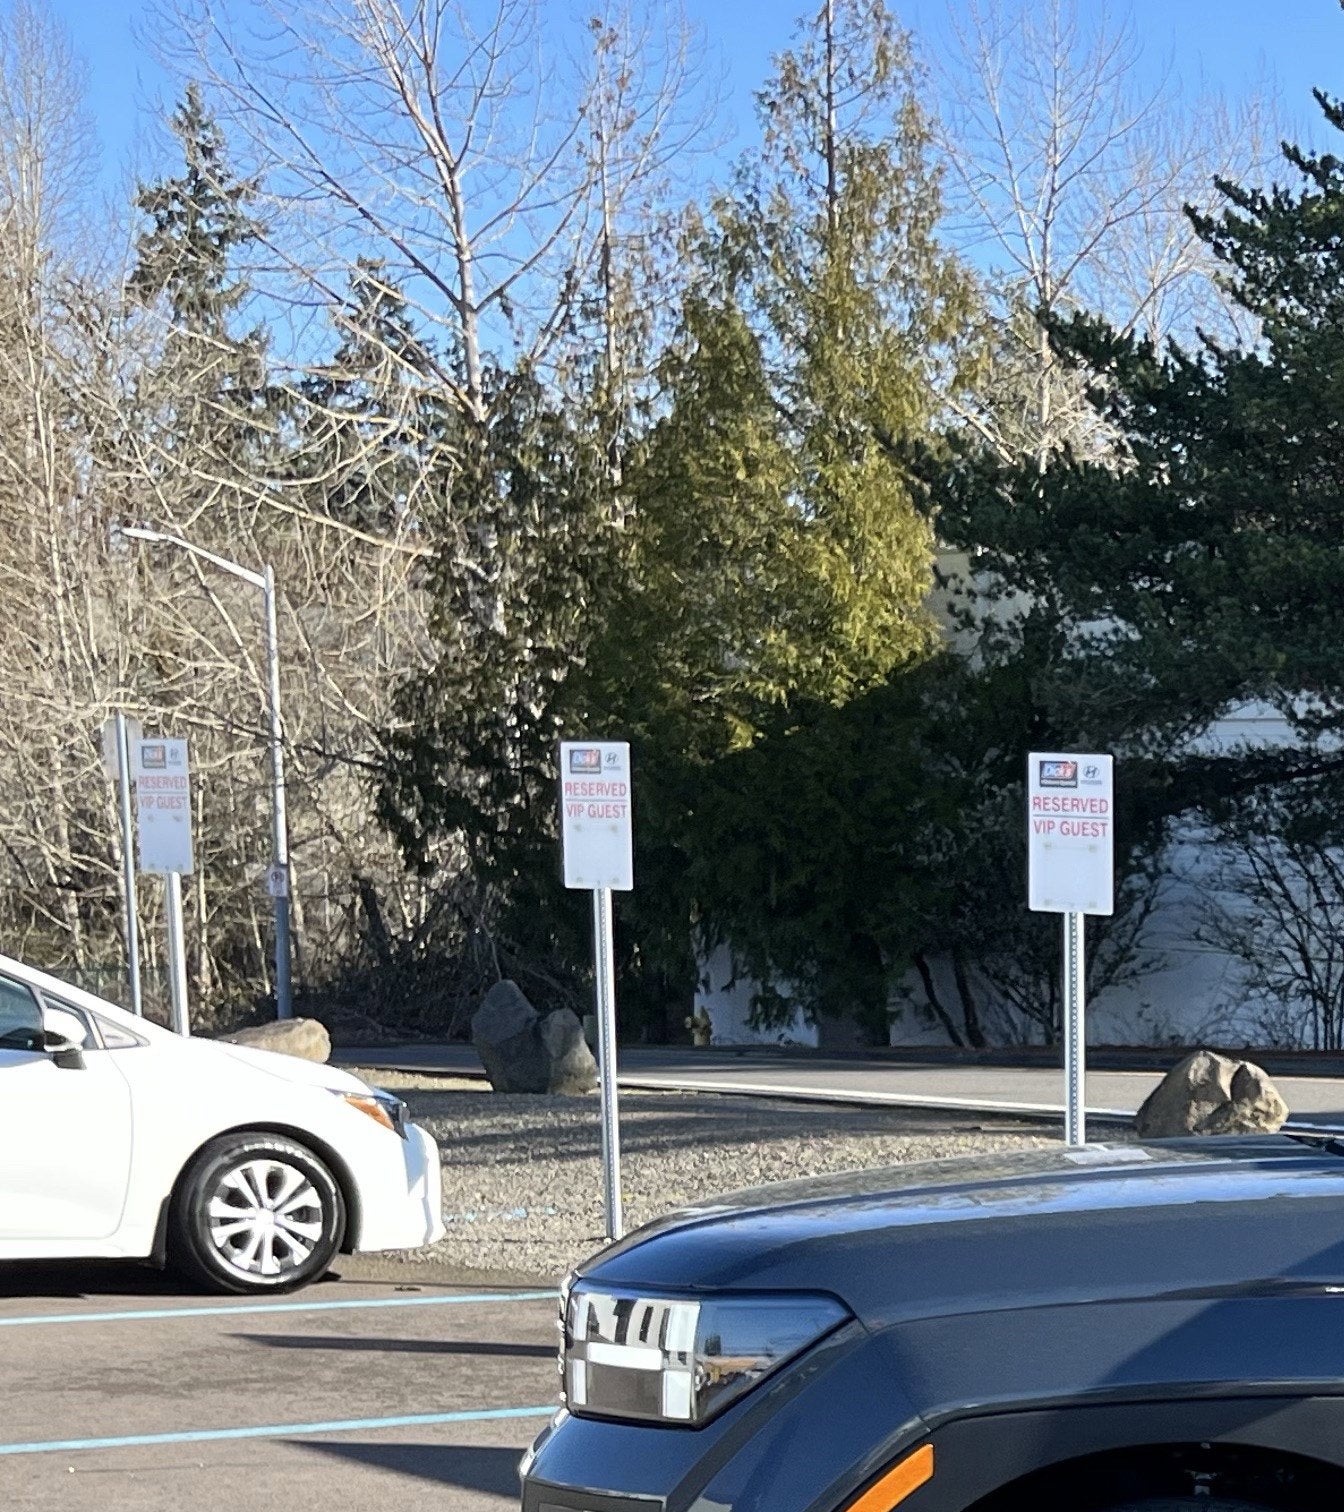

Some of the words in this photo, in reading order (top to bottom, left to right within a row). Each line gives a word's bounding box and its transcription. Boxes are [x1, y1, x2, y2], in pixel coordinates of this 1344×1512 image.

[138, 775, 187, 789] RESERVED
[564, 782, 627, 797] RESERVED
[140, 795, 154, 809] VIP
[157, 796, 187, 810] GUEST
[1032, 796, 1108, 813] RESERVED
[566, 804, 584, 818] VIP
[588, 804, 627, 819] GUEST
[1034, 820, 1055, 834] VIP
[1060, 821, 1108, 837] GUEST
